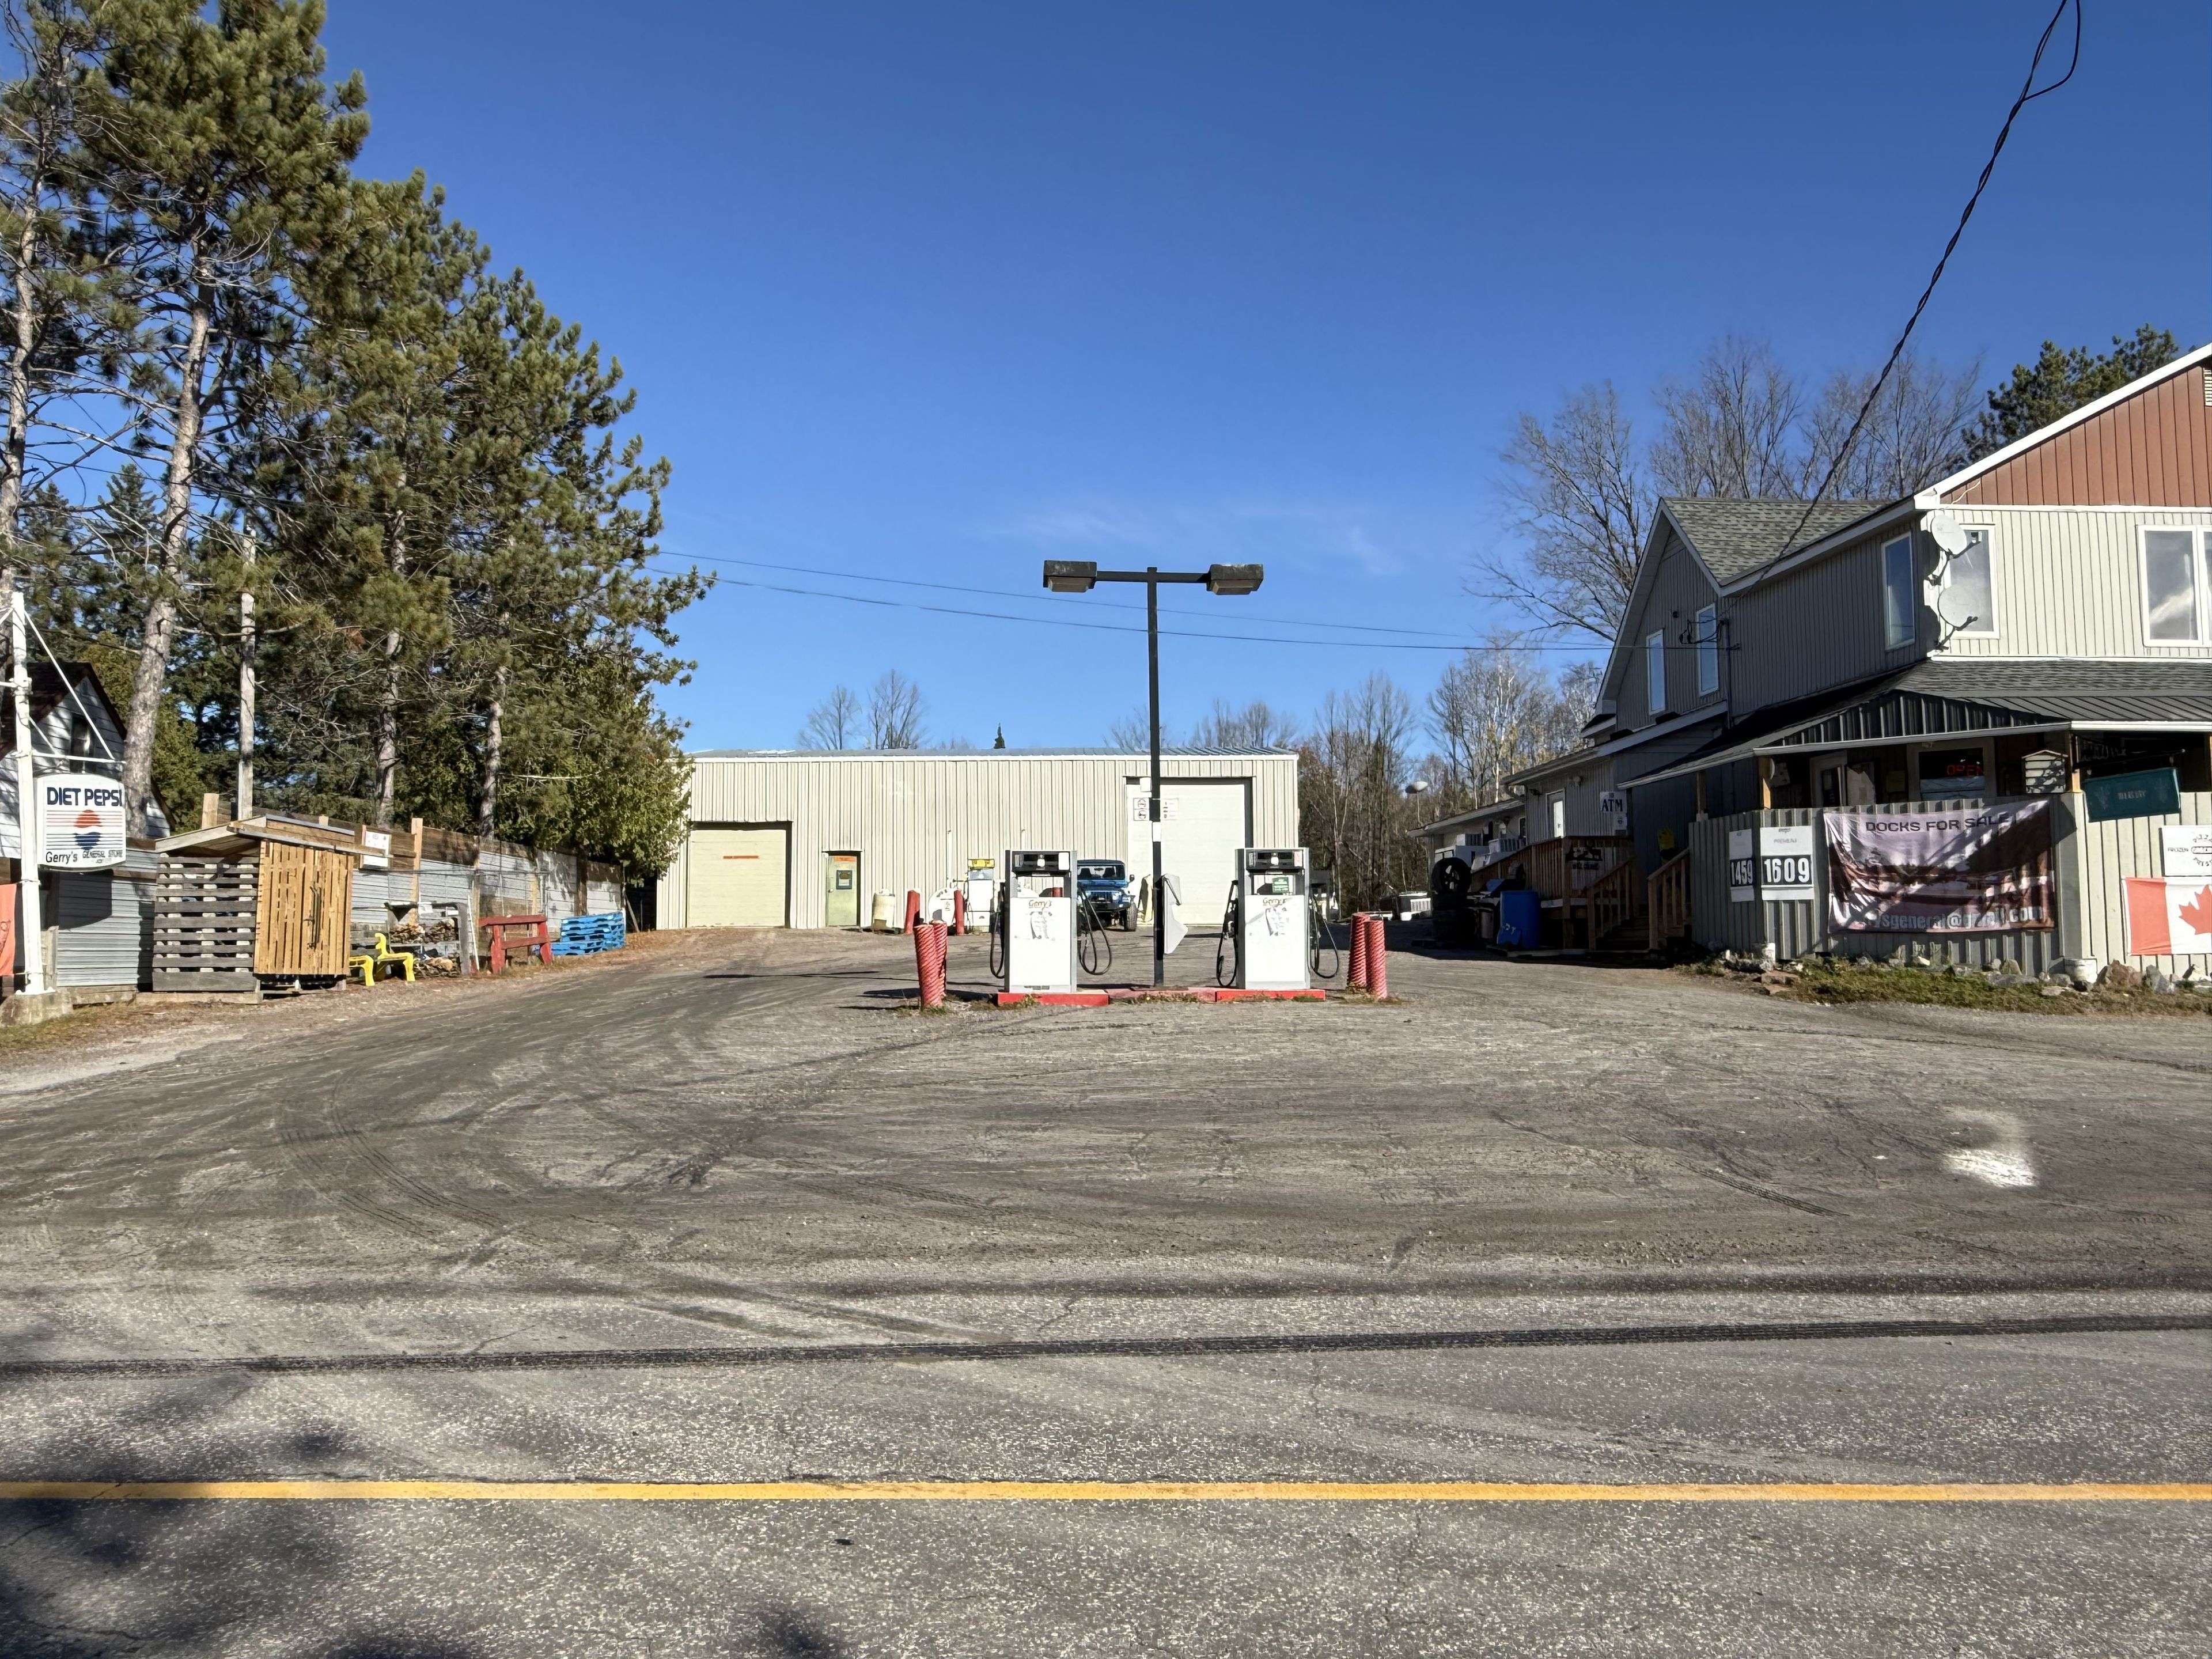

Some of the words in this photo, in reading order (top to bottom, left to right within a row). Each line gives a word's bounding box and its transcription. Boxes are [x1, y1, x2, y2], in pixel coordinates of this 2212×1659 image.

[47, 787, 81, 806] DIET
[85, 789, 123, 807] PEPSI
[1601, 799, 1623, 812] ATM
[1866, 821, 1921, 832] DOCKS
[1926, 820, 1960, 831] FOR
[46, 851, 78, 865] Gerry's
[1731, 859, 1753, 885] 1459
[1764, 857, 1810, 883] 1609
